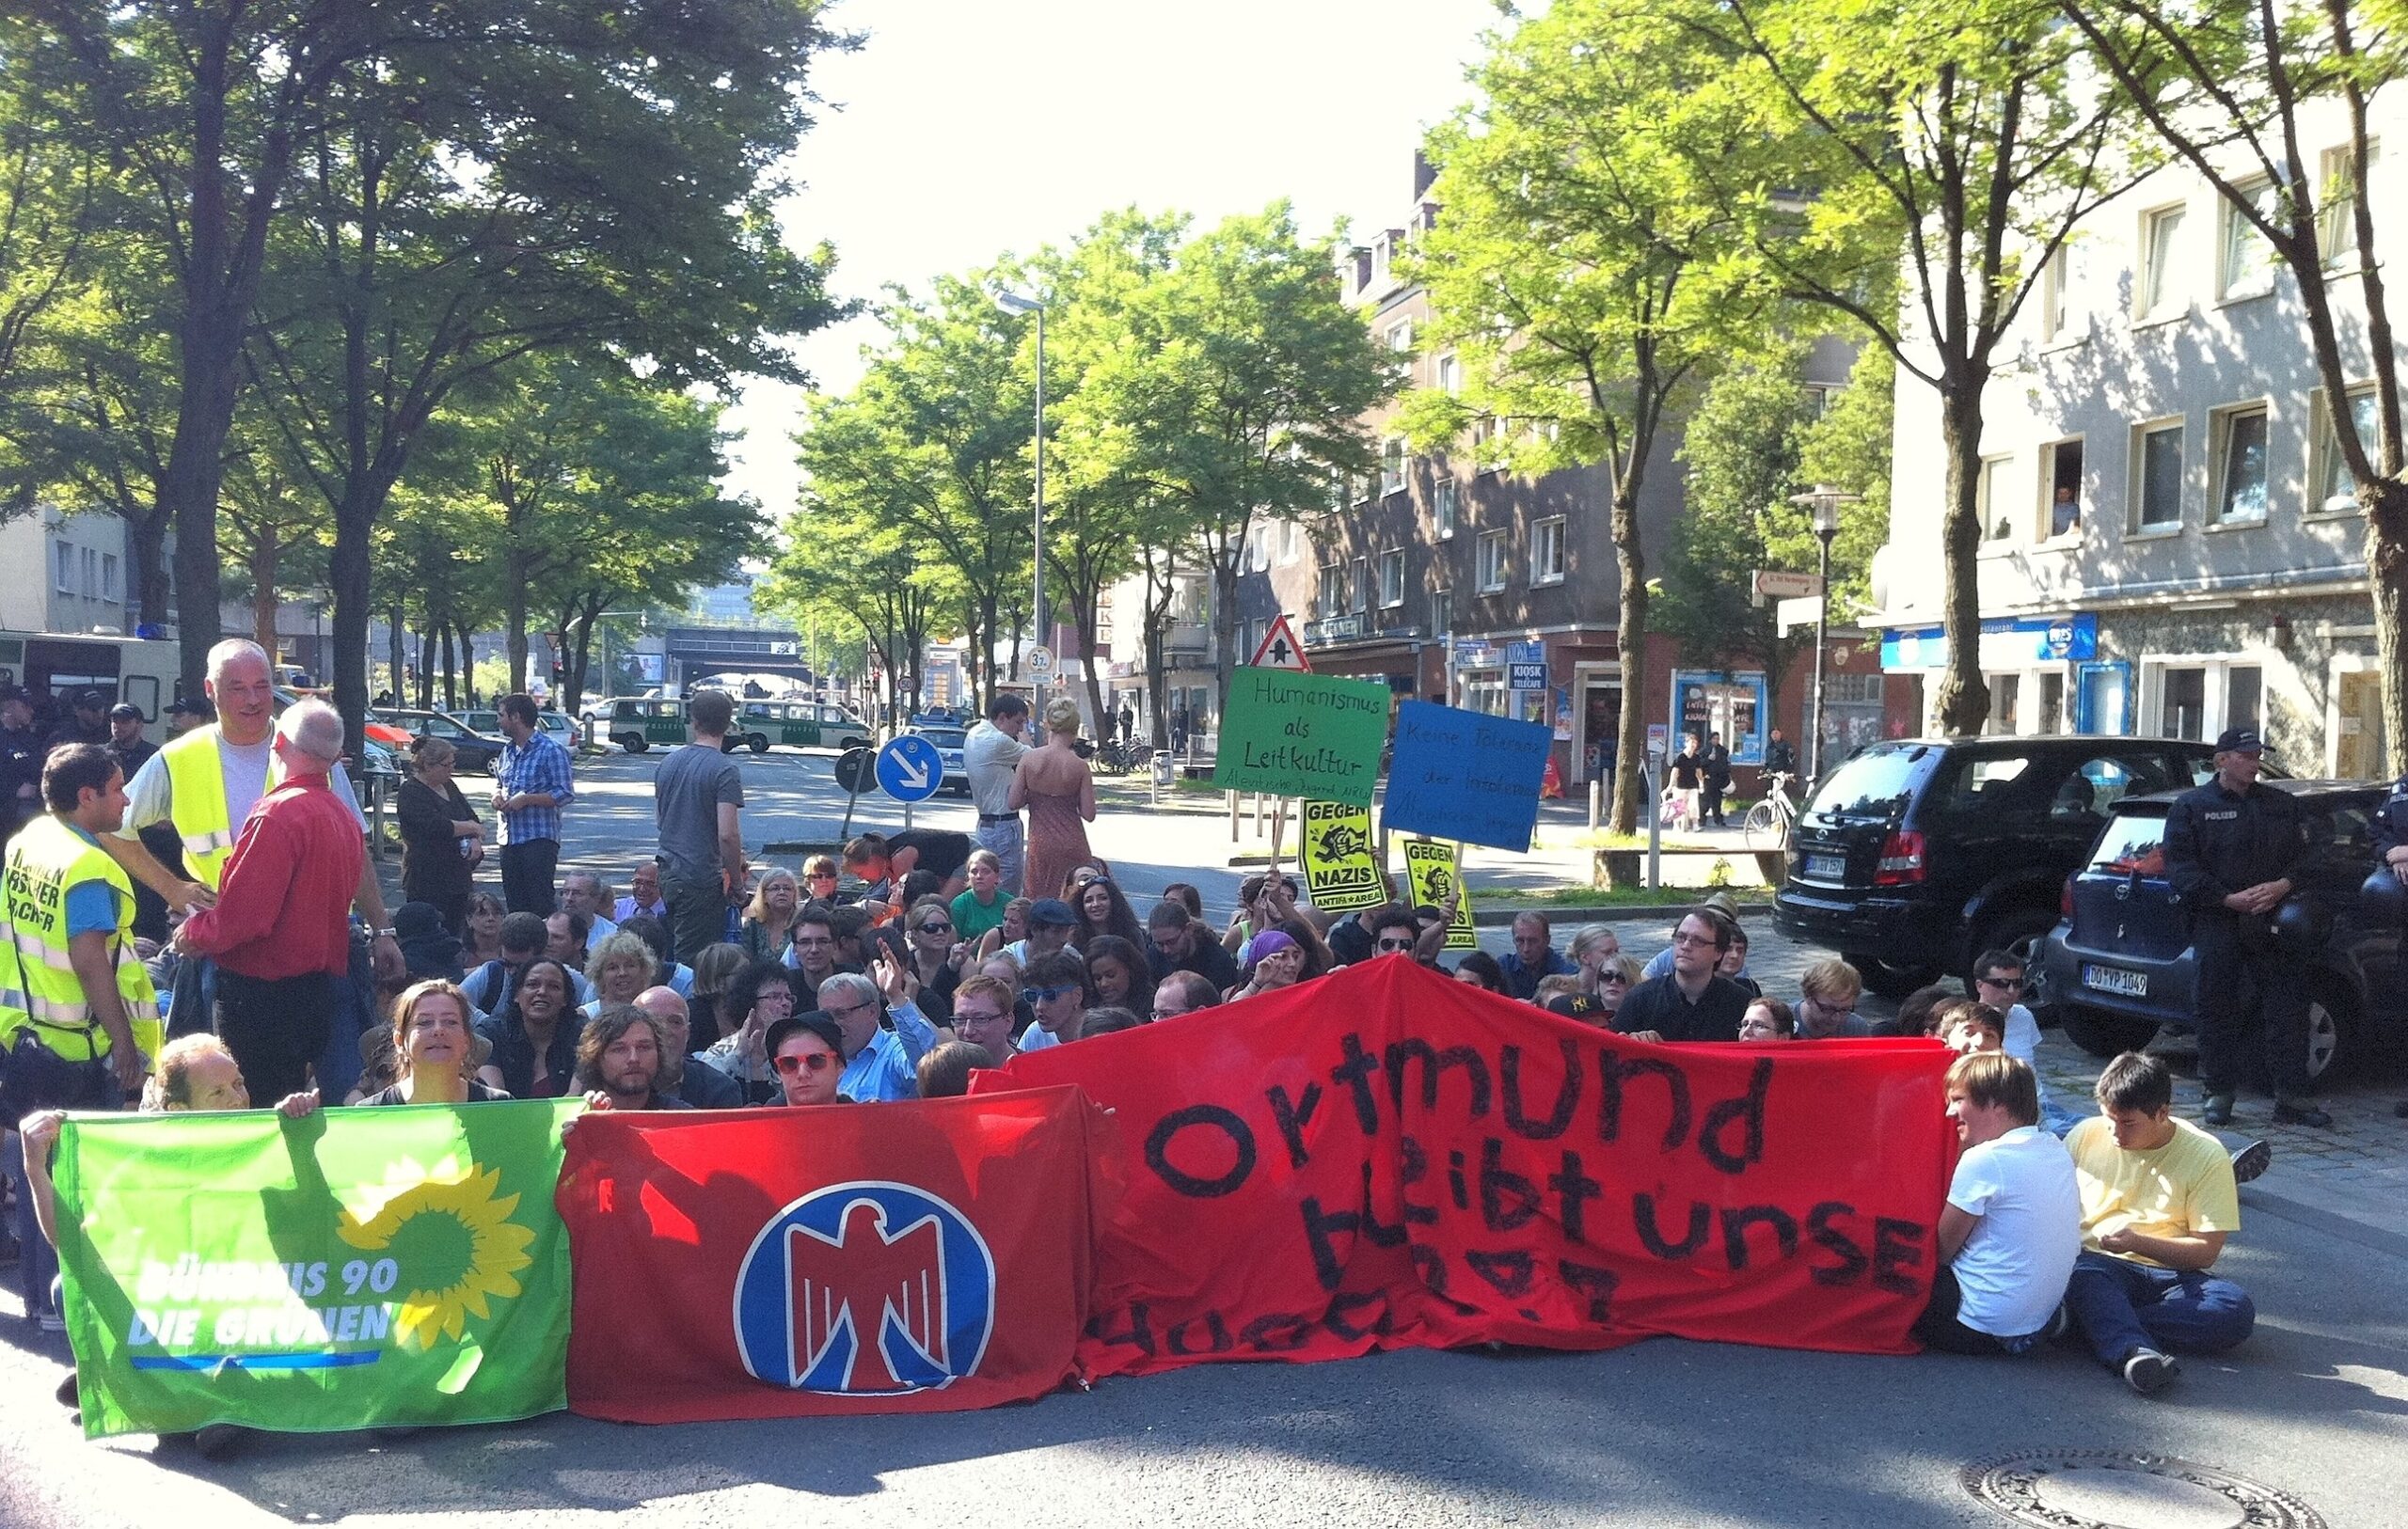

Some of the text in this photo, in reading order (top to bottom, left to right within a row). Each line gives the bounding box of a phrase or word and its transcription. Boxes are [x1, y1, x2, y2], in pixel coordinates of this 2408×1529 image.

[1980, 623, 2014, 634] estaurant
[1513, 666, 1542, 677] KIOSK
[901, 681, 911, 689] 50
[1254, 677, 1380, 715] Humanismus
[1285, 717, 1310, 738] als
[1407, 720, 1460, 746] Keine
[1244, 742, 1362, 777] Leitkultur
[1423, 769, 1452, 785] der
[1307, 804, 1366, 821] GEGEN
[2205, 811, 2238, 821] POLIZEI
[1409, 845, 1454, 863] GEGEN
[1315, 867, 1372, 887] NAZIS
[1317, 892, 1381, 907] ANTIFA AREA
[1451, 936, 1474, 944] AREA
[2090, 967, 2147, 993] DO YP 1049
[341, 1258, 398, 1296] 90
[127, 1302, 394, 1347] DIE GRÜNEN
